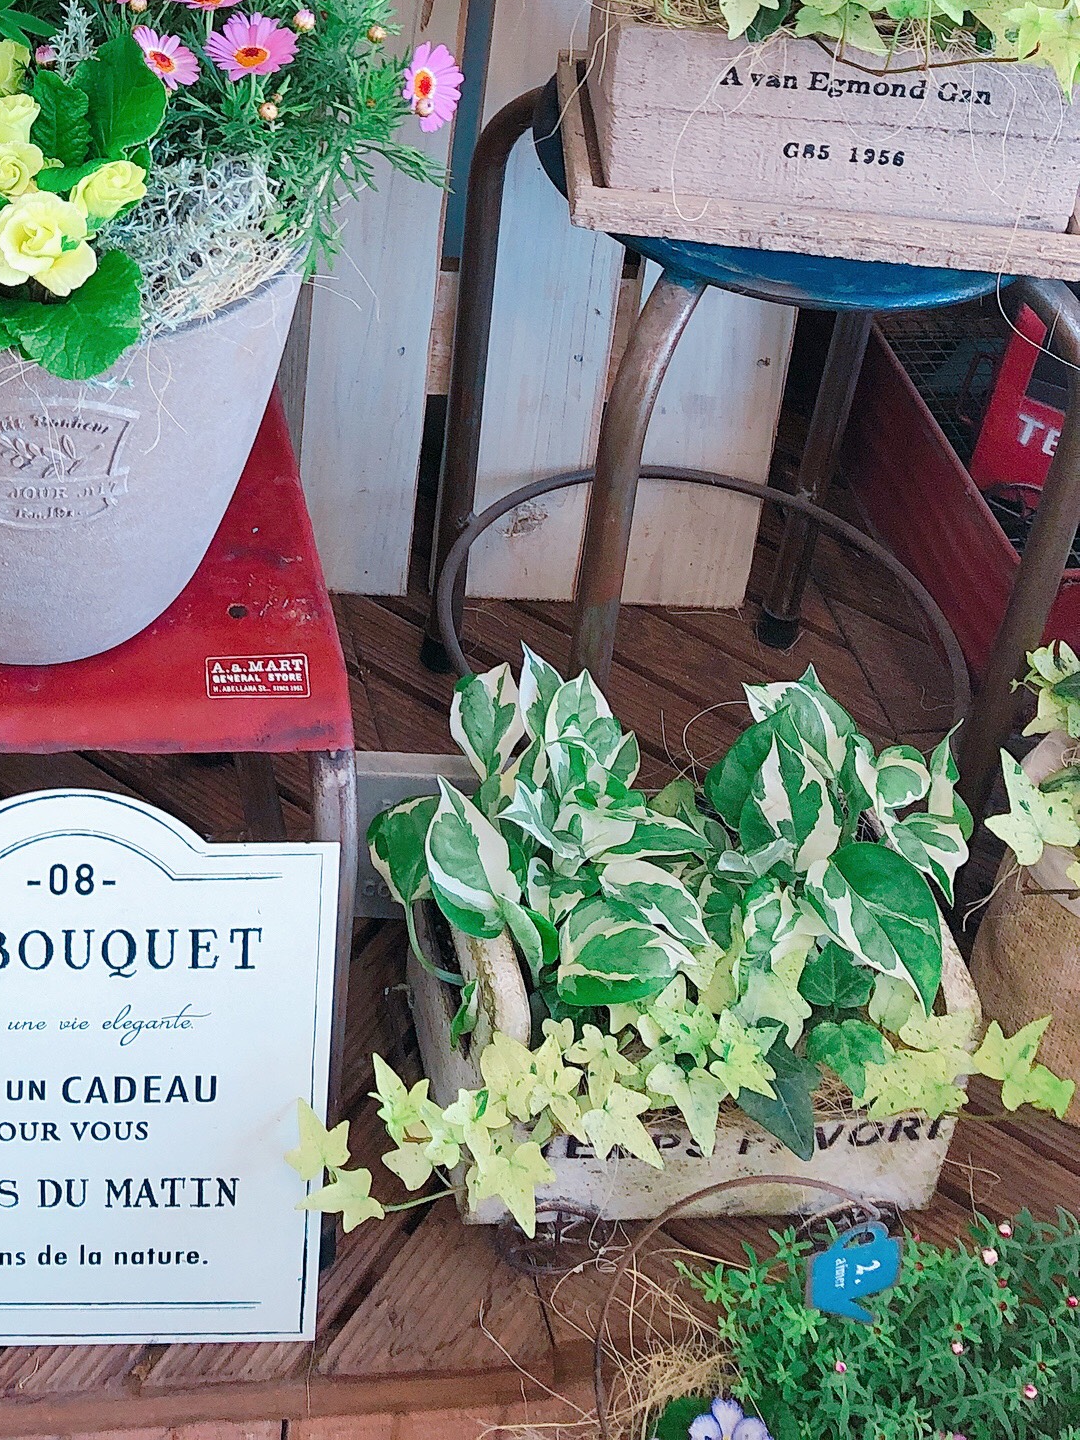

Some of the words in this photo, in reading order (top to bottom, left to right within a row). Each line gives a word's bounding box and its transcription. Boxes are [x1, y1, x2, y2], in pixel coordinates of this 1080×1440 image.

[720, 66, 743, 87] A
[751, 73, 798, 90] van
[807, 71, 926, 99] Egmond
[849, 147, 905, 167] 1956
[212, 673, 261, 683] GENERAL
[268, 673, 302, 682] STORE
[7, 1019, 47, 1032] une
[59, 1015, 90, 1032] vie
[7, 1080, 46, 1101] UN
[61, 1075, 217, 1104] CADEAU
[70, 1121, 149, 1141] VOUS
[37, 1179, 89, 1209] DU
[105, 1177, 240, 1208] MATIN
[38, 1245, 68, 1266] de
[80, 1245, 102, 1266] la
[114, 1247, 209, 1266] nature.
